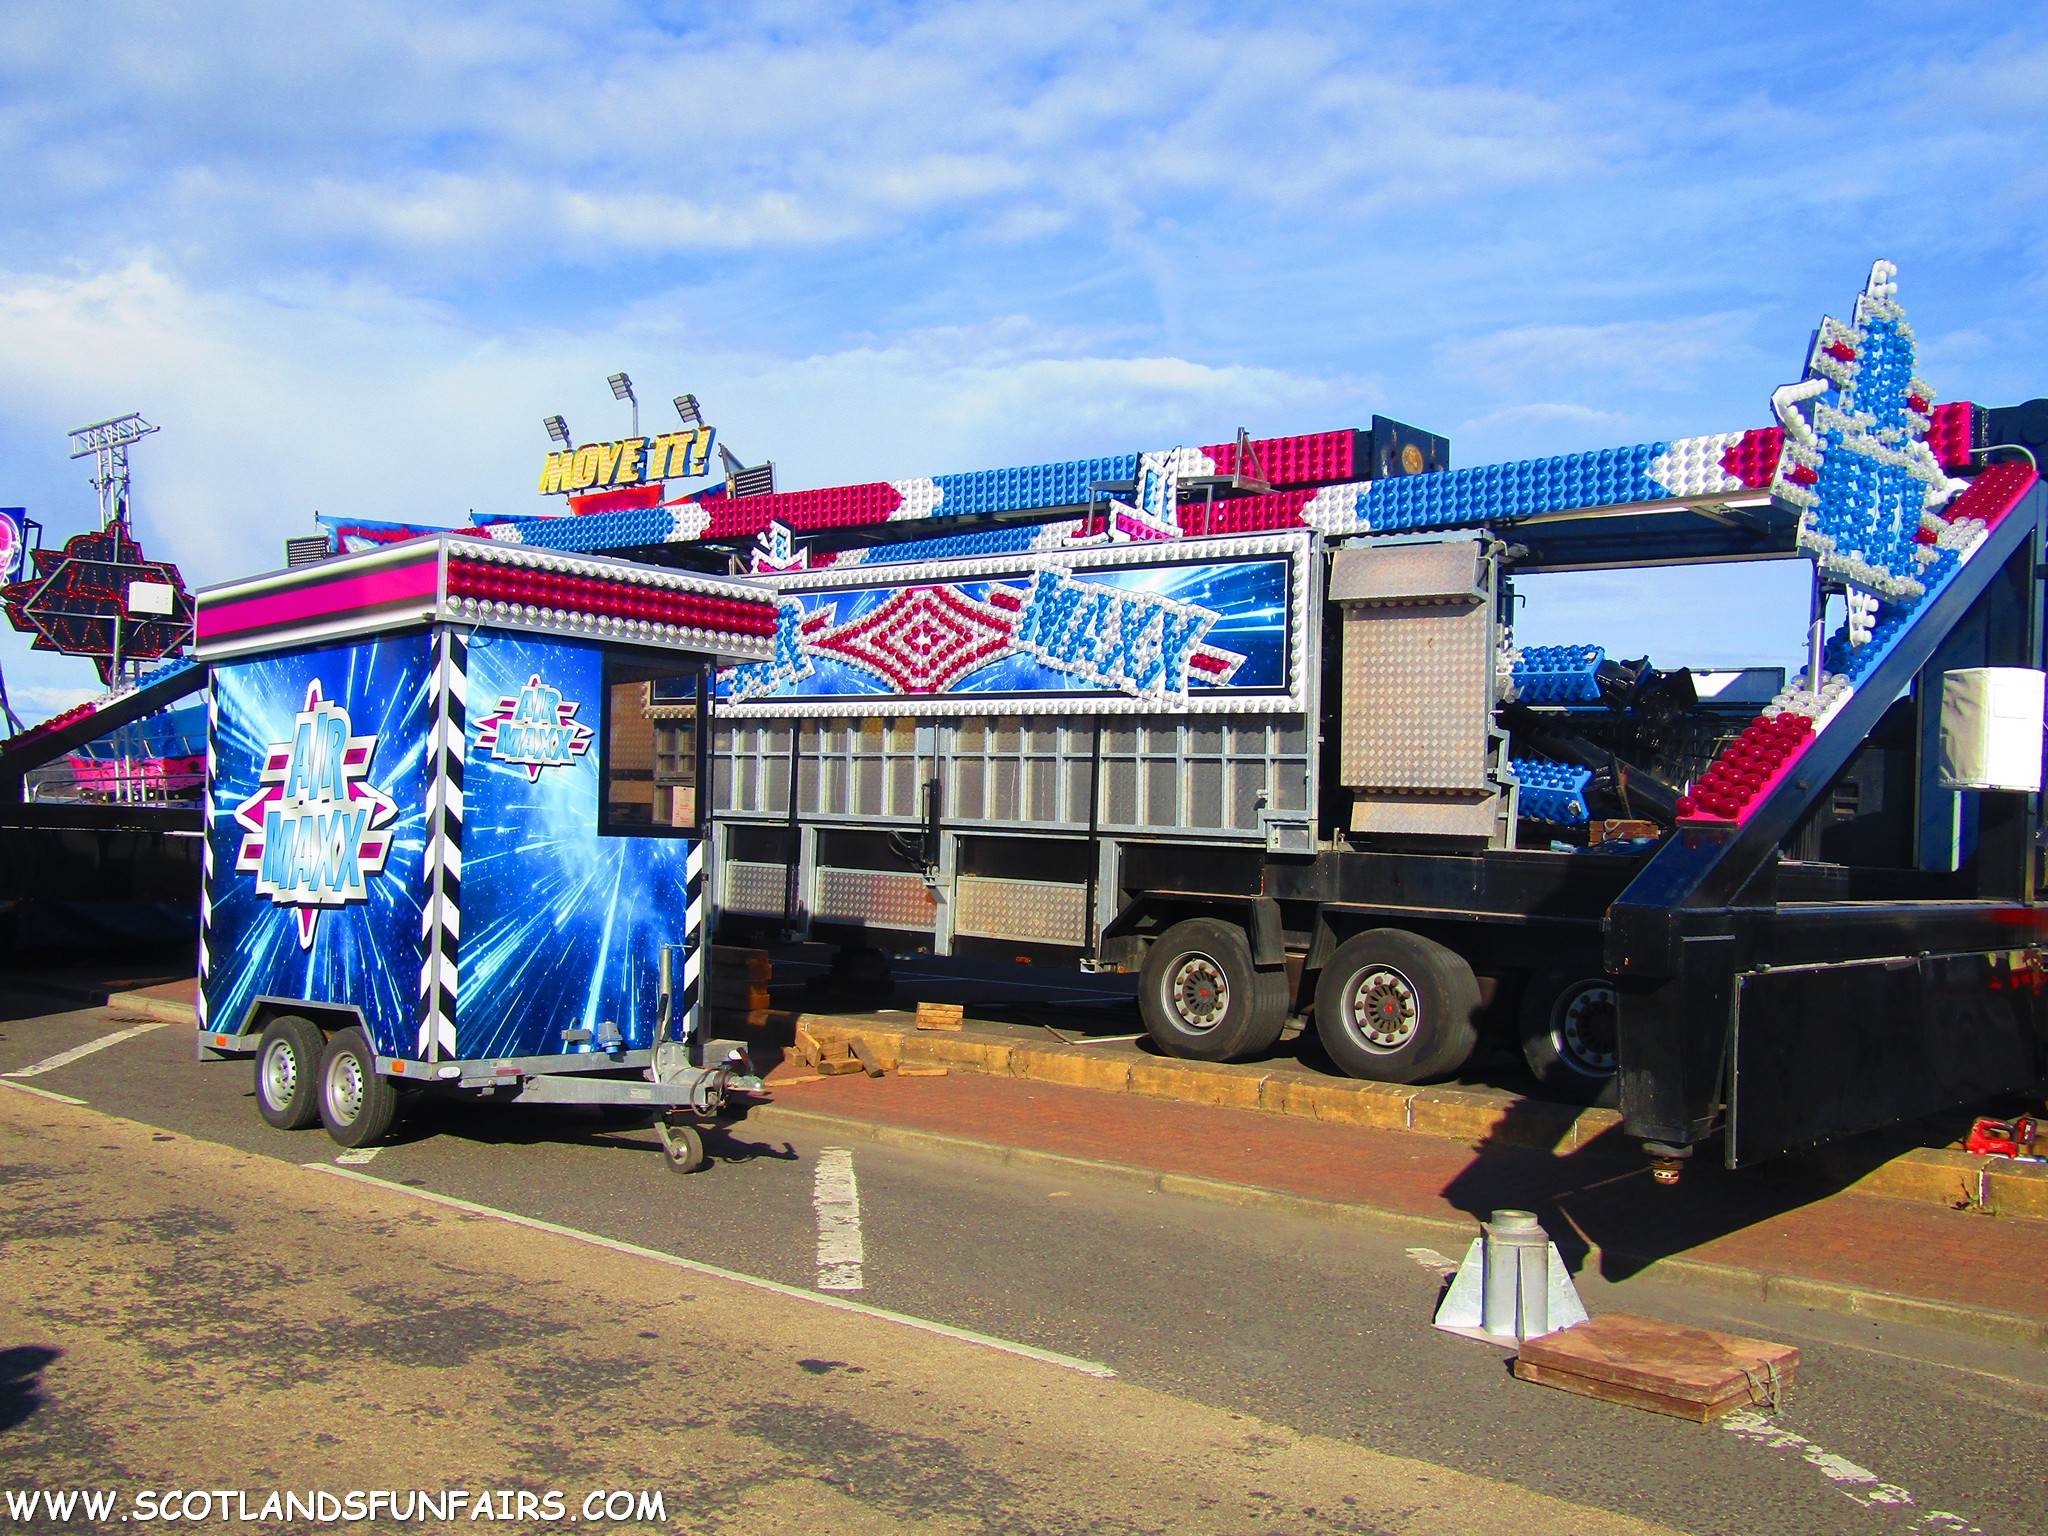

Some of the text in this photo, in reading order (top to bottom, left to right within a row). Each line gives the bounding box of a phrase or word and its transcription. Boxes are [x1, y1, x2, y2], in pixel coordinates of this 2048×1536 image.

[538, 426, 716, 495] MOVE IT!
[1019, 568, 1208, 696] MAXX
[495, 723, 574, 760] MAXX
[515, 687, 560, 725] AIR
[286, 712, 346, 800] AIR
[261, 808, 367, 892] MAXX
